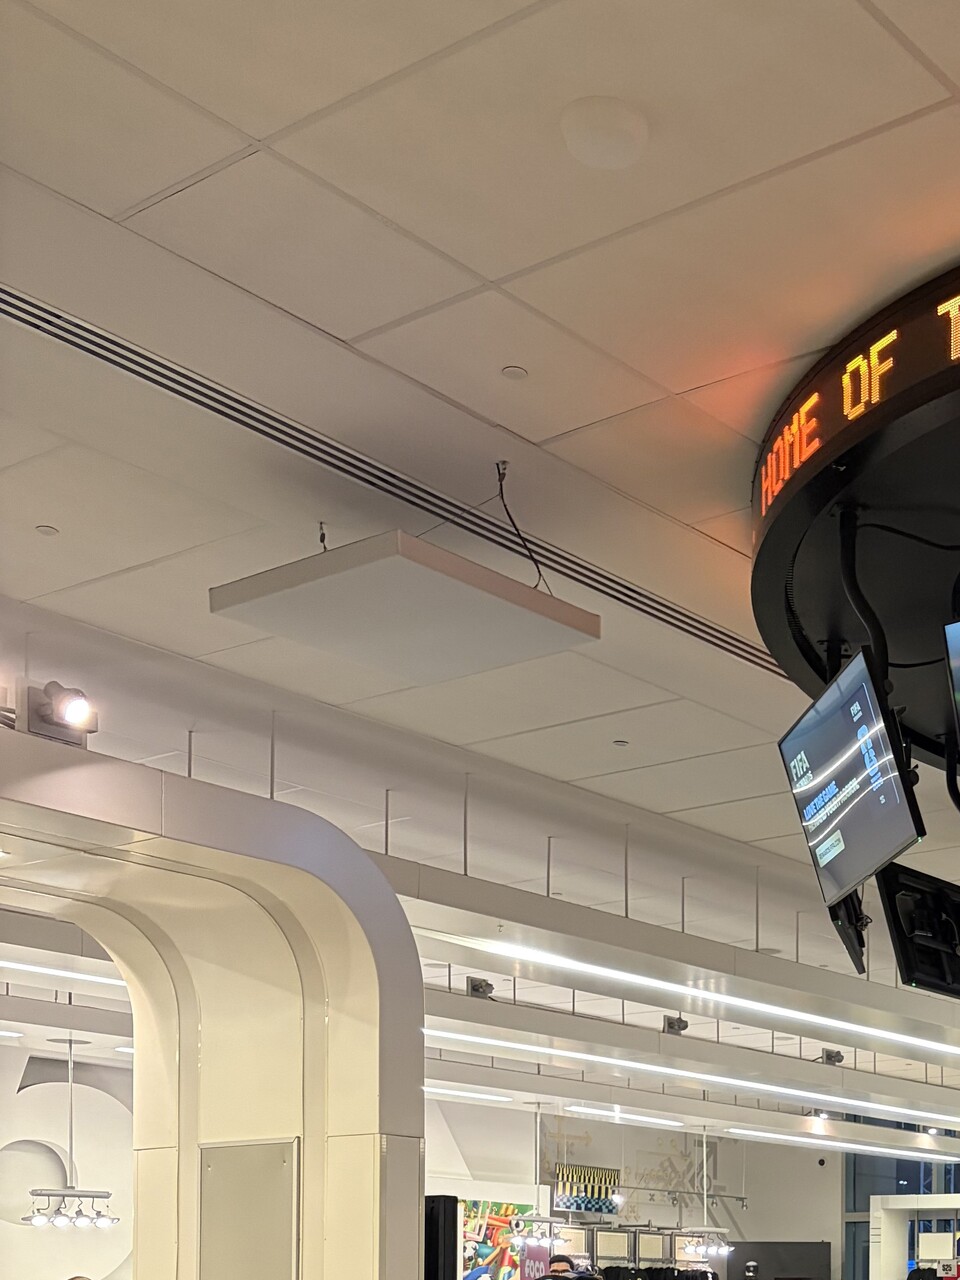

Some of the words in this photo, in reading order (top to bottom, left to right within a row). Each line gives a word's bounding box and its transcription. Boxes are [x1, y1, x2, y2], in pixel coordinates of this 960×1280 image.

[761, 392, 822, 516] HOME
[842, 329, 898, 420] OF
[789, 750, 810, 781] FIFA
